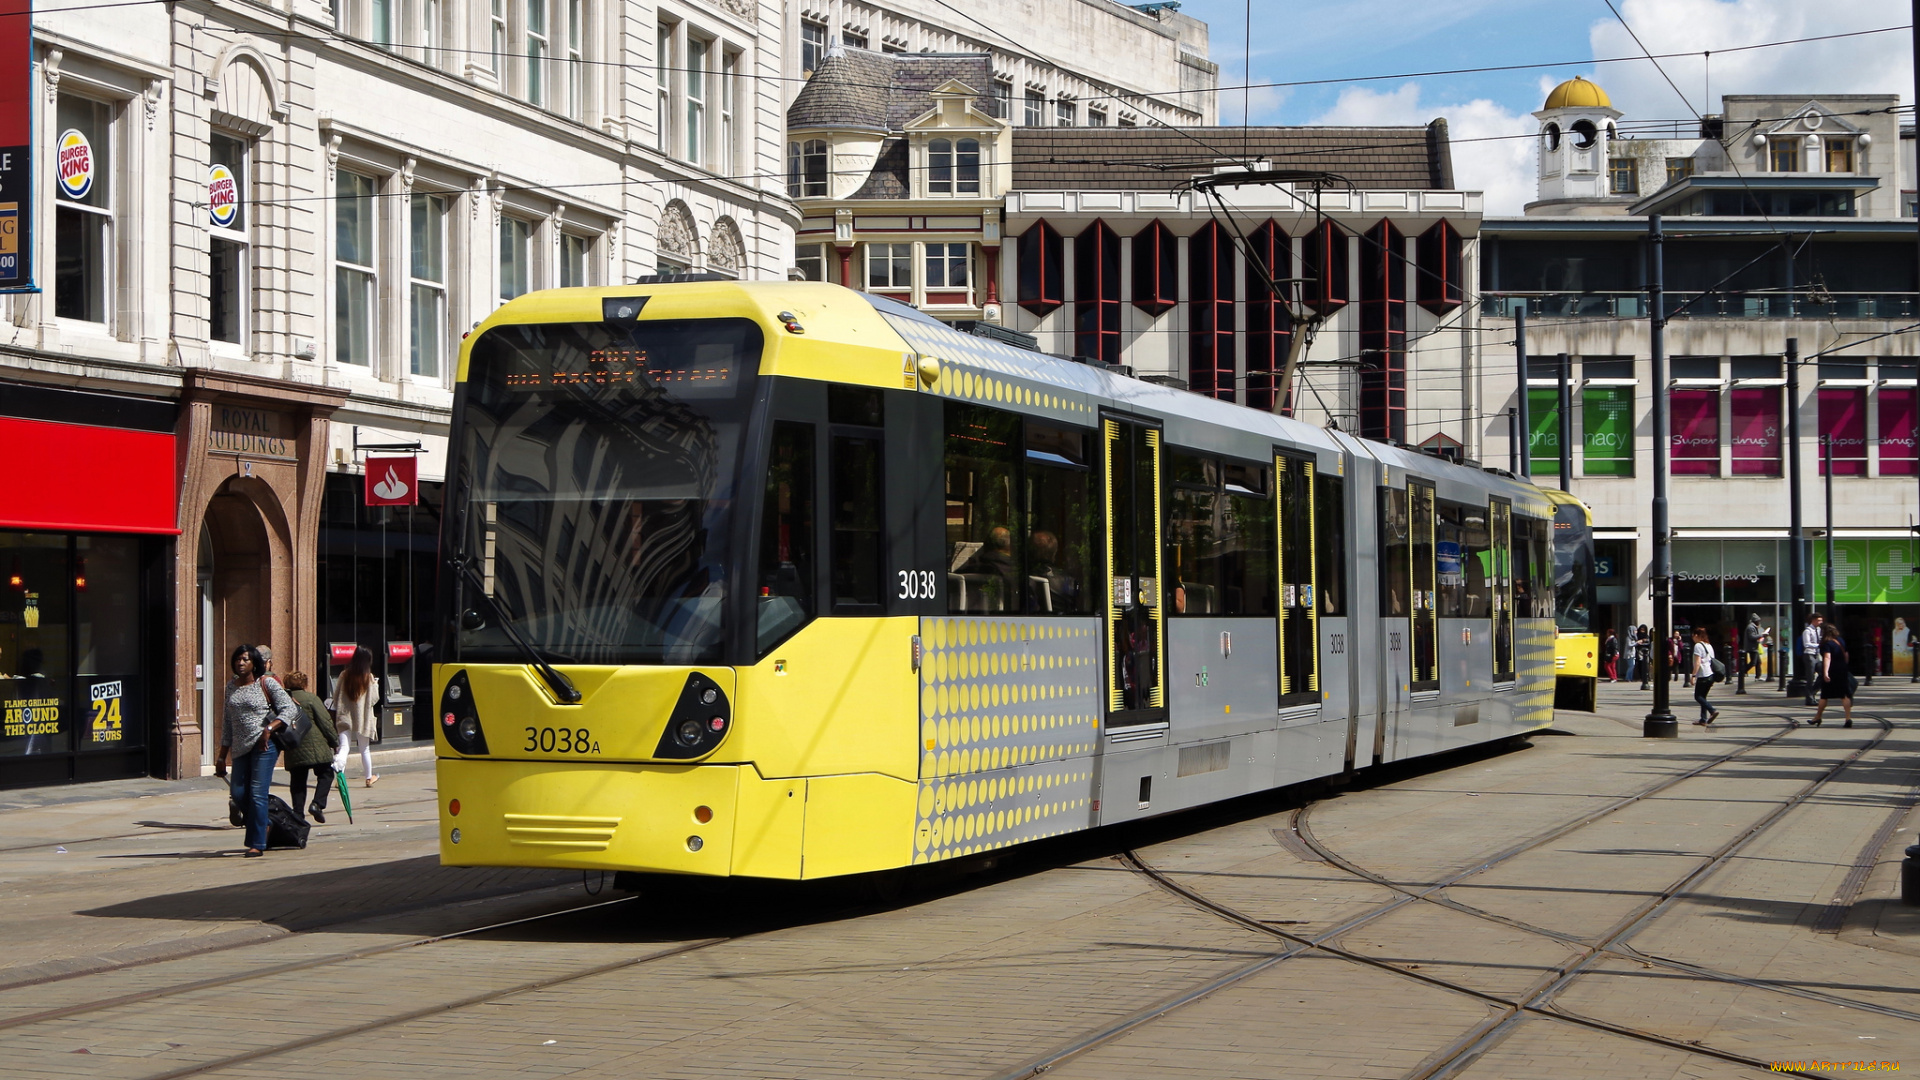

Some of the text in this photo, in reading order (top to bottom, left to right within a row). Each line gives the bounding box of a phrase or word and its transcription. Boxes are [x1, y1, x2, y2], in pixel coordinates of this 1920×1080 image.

[60, 145, 88, 163] BURGER
[61, 157, 89, 180] KING
[209, 178, 233, 195] BURGER
[210, 189, 234, 210] KING
[222, 408, 270, 432] ROYAL
[245, 461, 252, 477] 2
[898, 569, 936, 600] 3038
[1330, 633, 1345, 654] 3038
[1389, 632, 1402, 651] 3038
[92, 683, 120, 699] OPEN
[4, 698, 59, 708] FLAME GRILLING
[4, 707, 59, 723] AROUND
[92, 698, 121, 730] 24
[4, 722, 59, 736] THE CLOCK
[92, 730, 122, 742] HOURS
